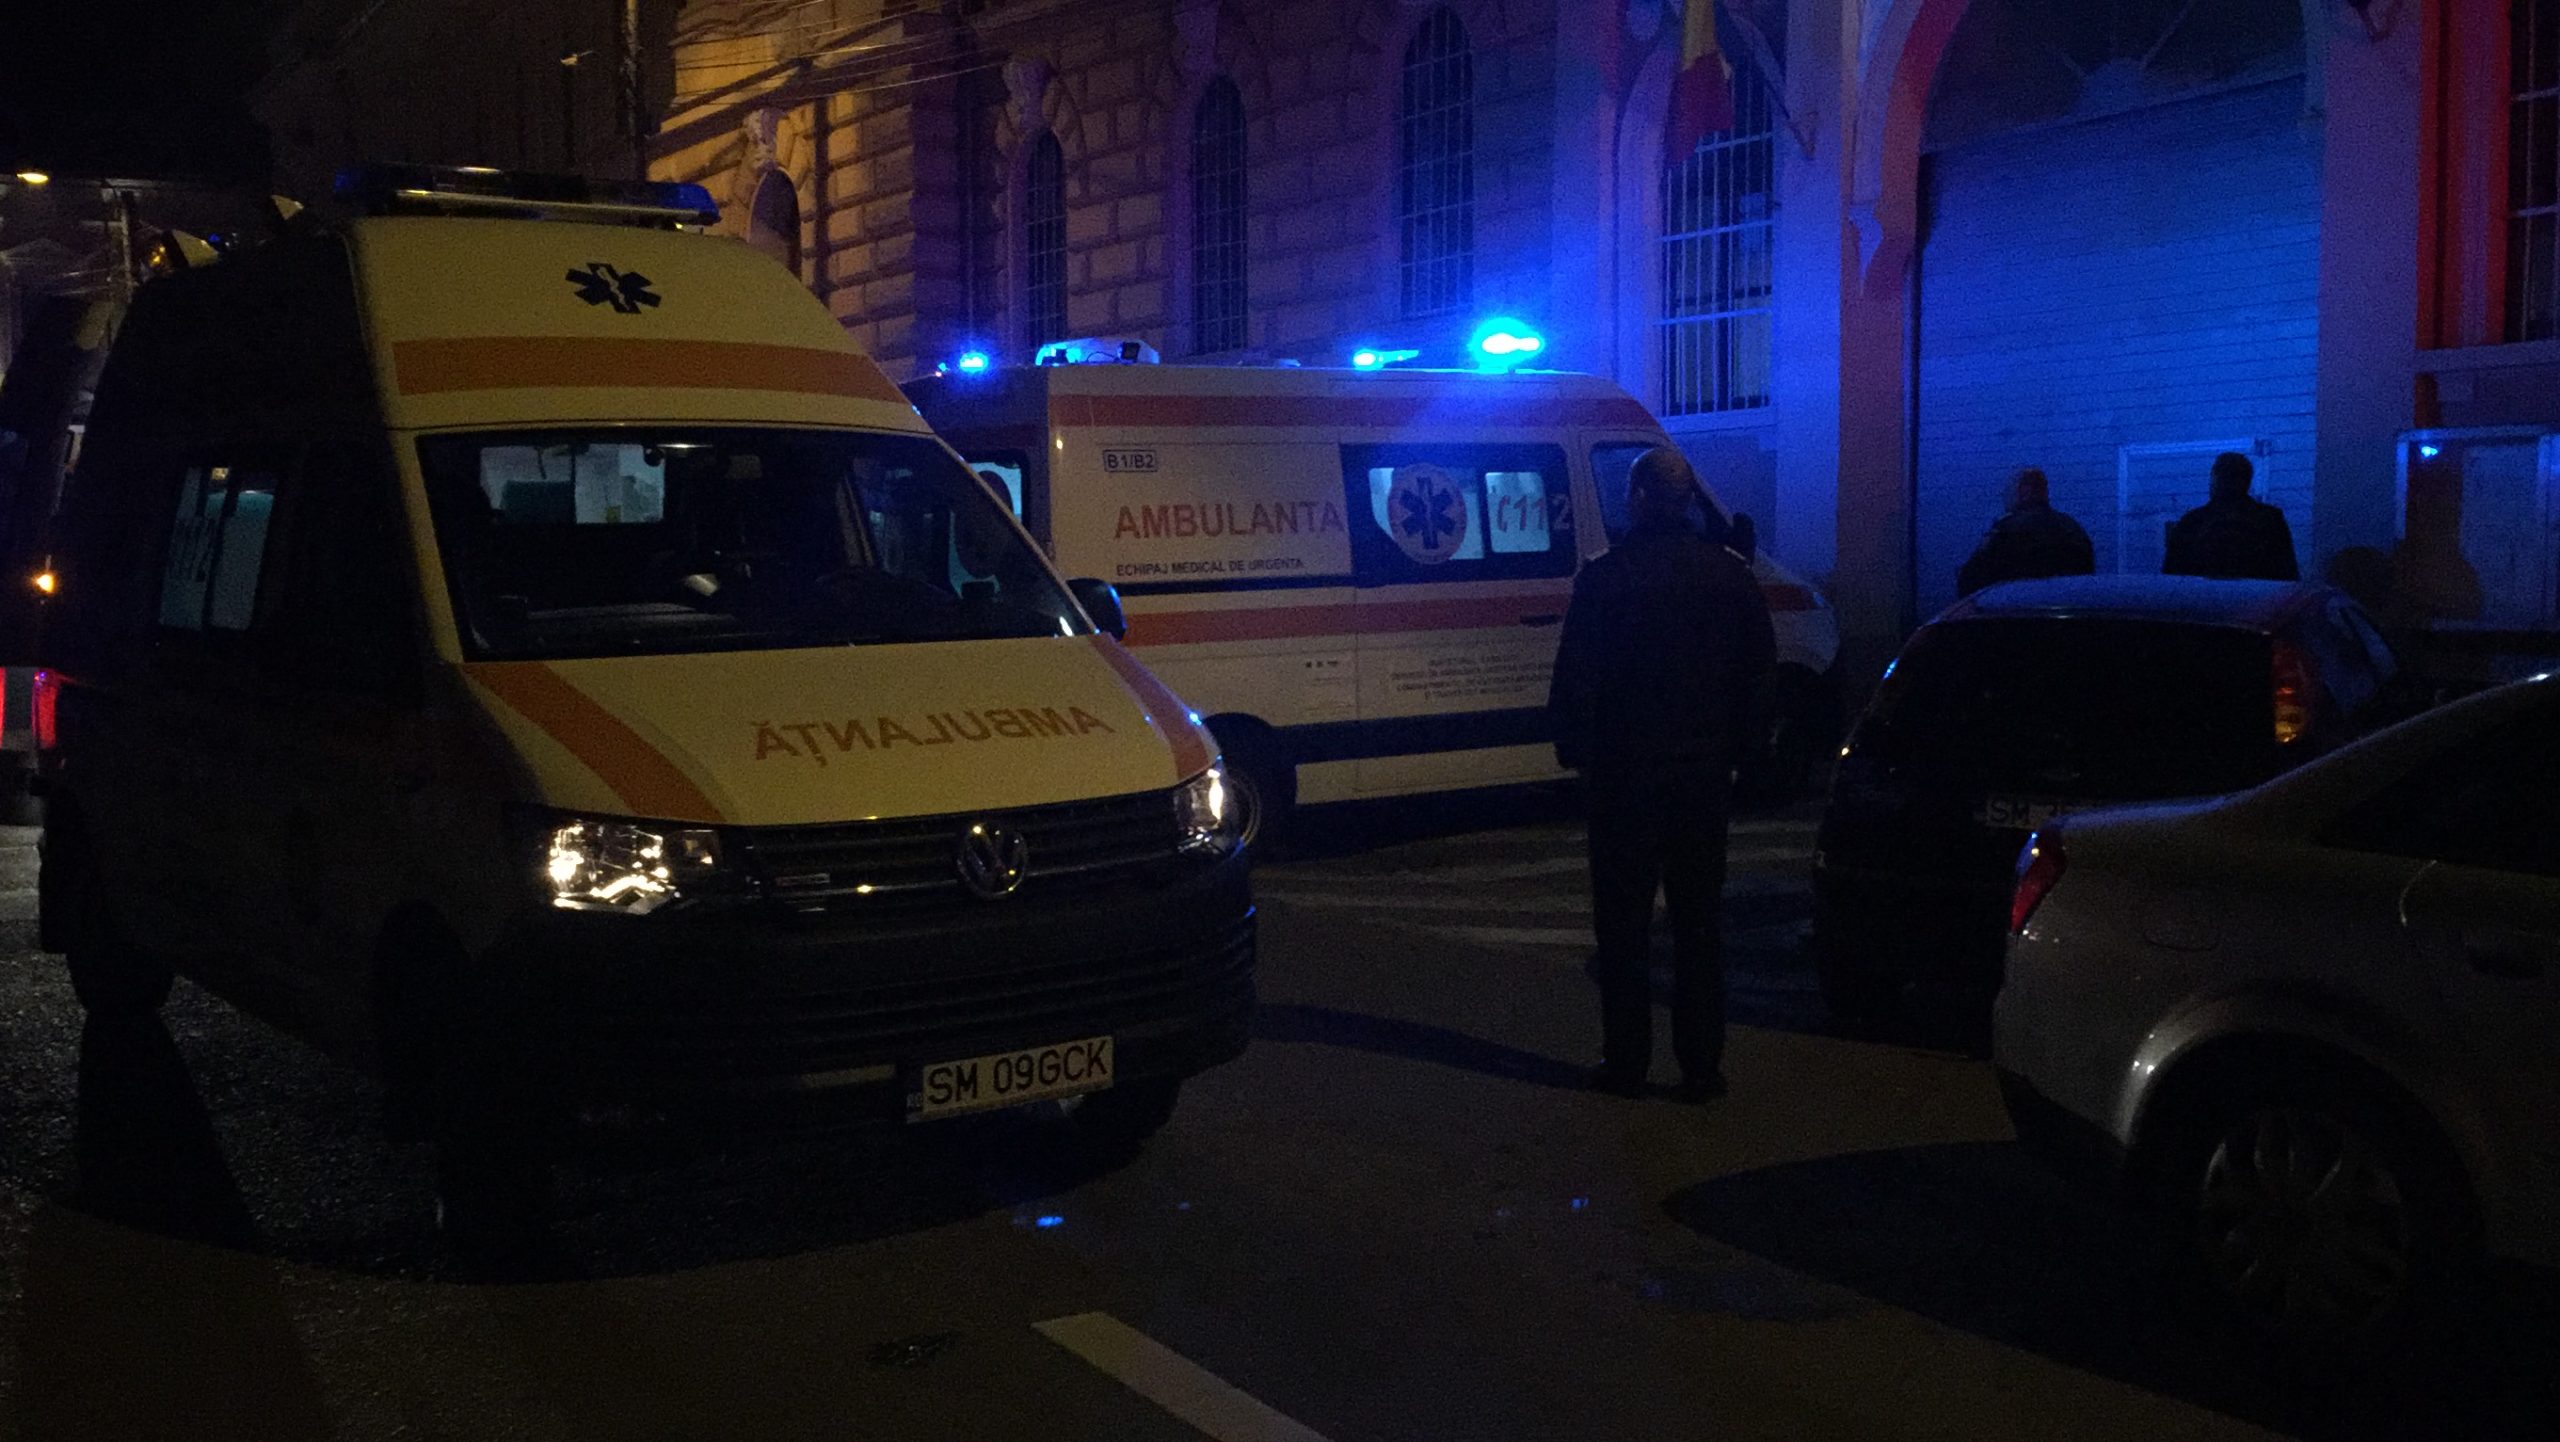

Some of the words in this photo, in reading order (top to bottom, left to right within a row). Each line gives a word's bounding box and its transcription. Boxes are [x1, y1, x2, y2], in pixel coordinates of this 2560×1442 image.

[1107, 453, 1155, 469] B1/B2
[1114, 501, 1344, 539] AMBULANTA
[1172, 560, 1225, 574] MEDICAL
[1229, 560, 1246, 572] DE
[928, 1063, 978, 1104] SM
[994, 1040, 1107, 1093] 09GCK
